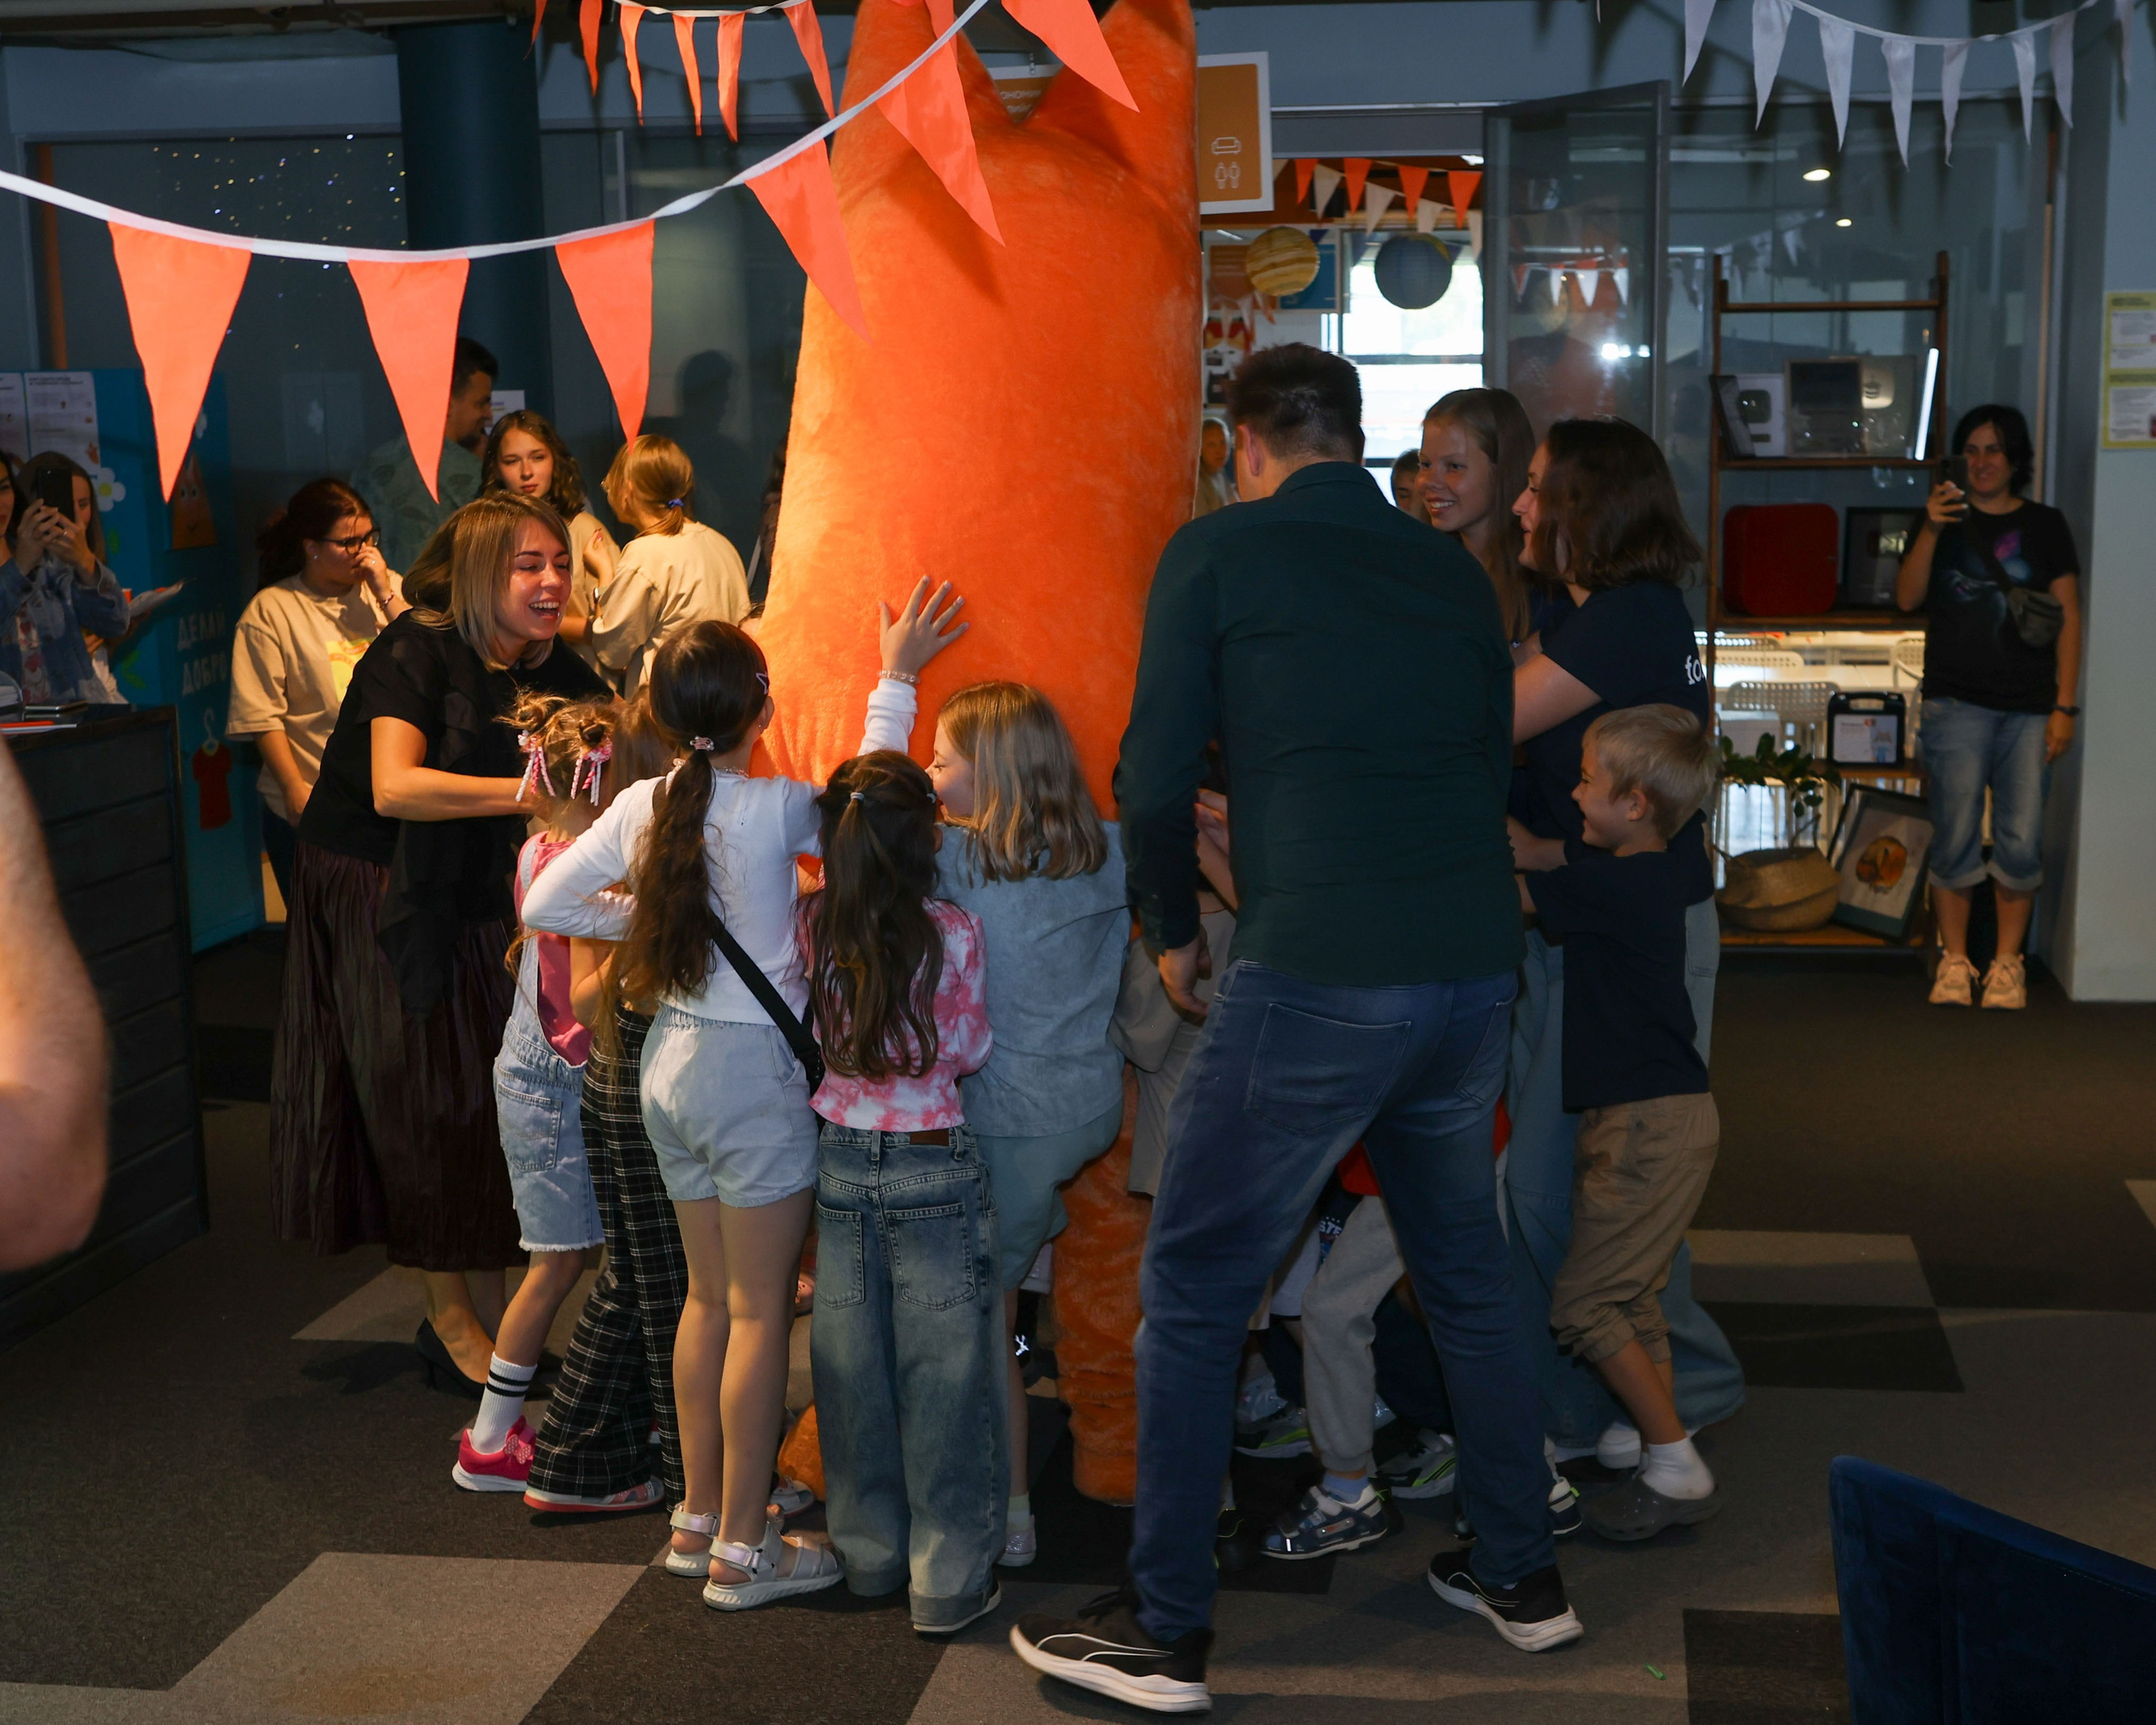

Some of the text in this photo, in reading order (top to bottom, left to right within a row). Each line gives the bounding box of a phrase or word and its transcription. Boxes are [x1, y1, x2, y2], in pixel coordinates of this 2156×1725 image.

[177, 606, 226, 651] ДЕЛАЙ
[181, 652, 227, 697] ДОБРО
[1685, 654, 1705, 685] fo
